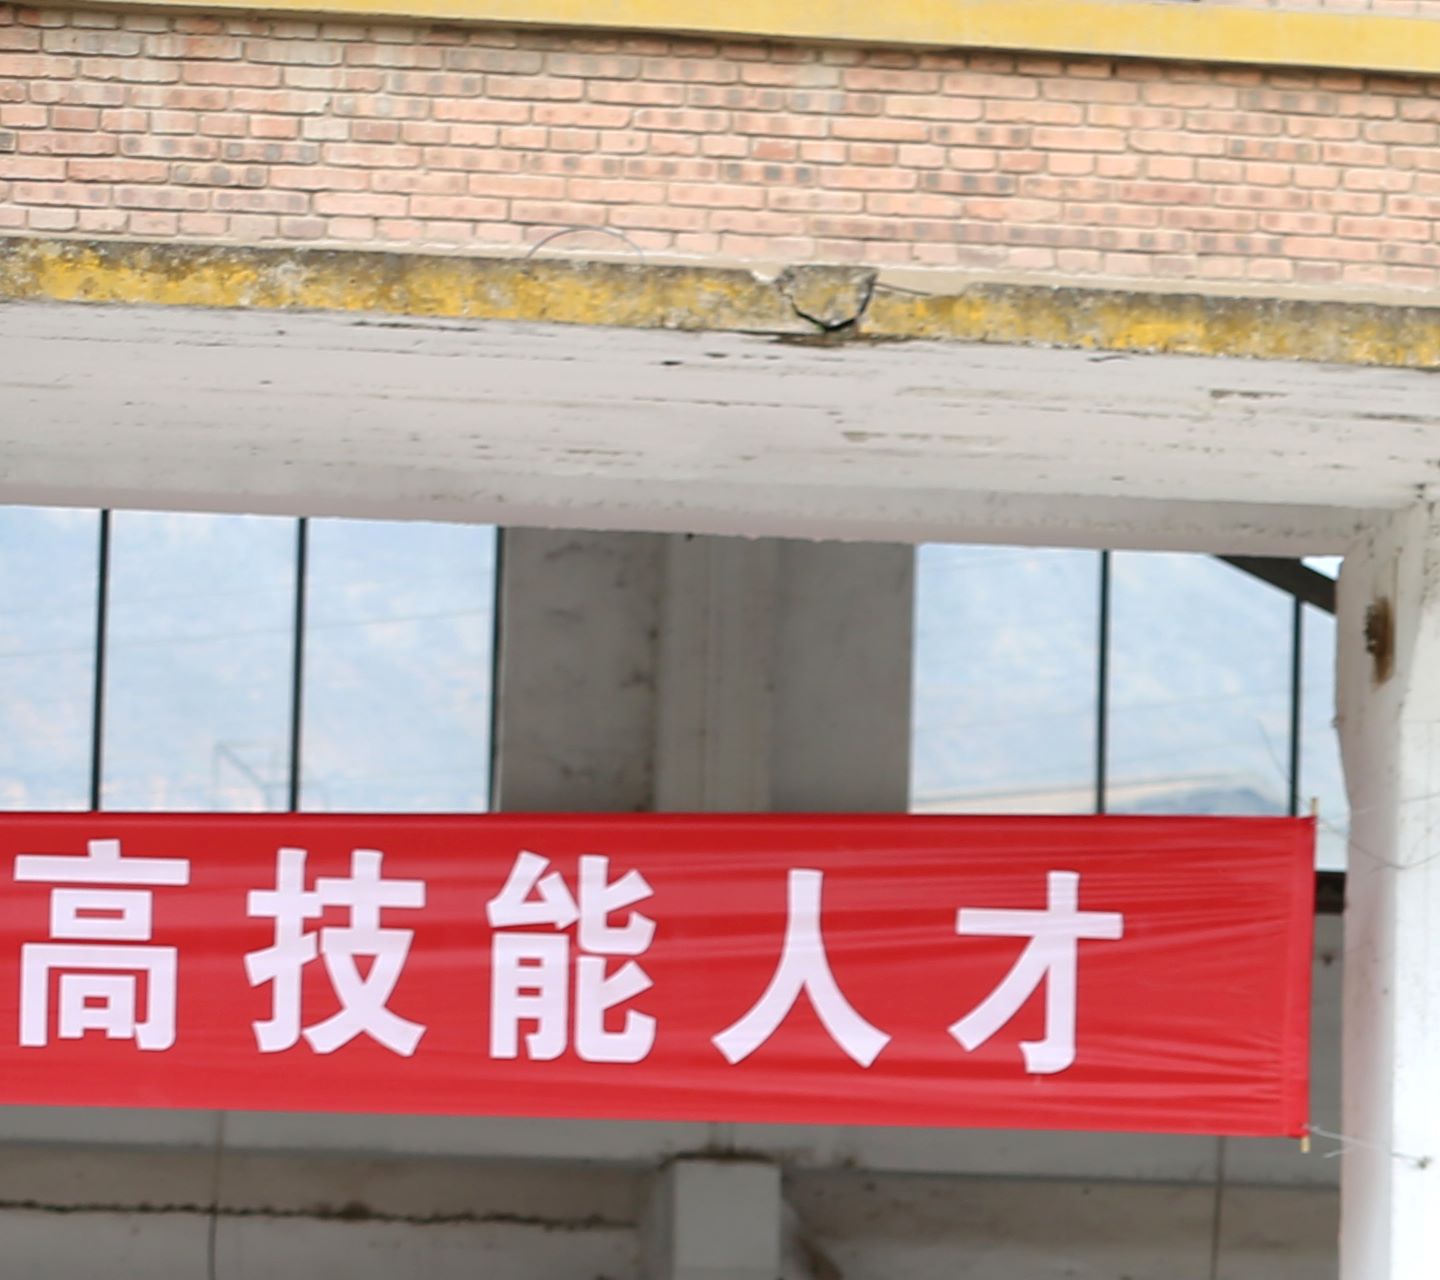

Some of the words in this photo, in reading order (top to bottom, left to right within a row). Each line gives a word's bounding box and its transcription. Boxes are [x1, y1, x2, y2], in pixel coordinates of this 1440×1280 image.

[13, 838, 1124, 1074] 高技能人才
